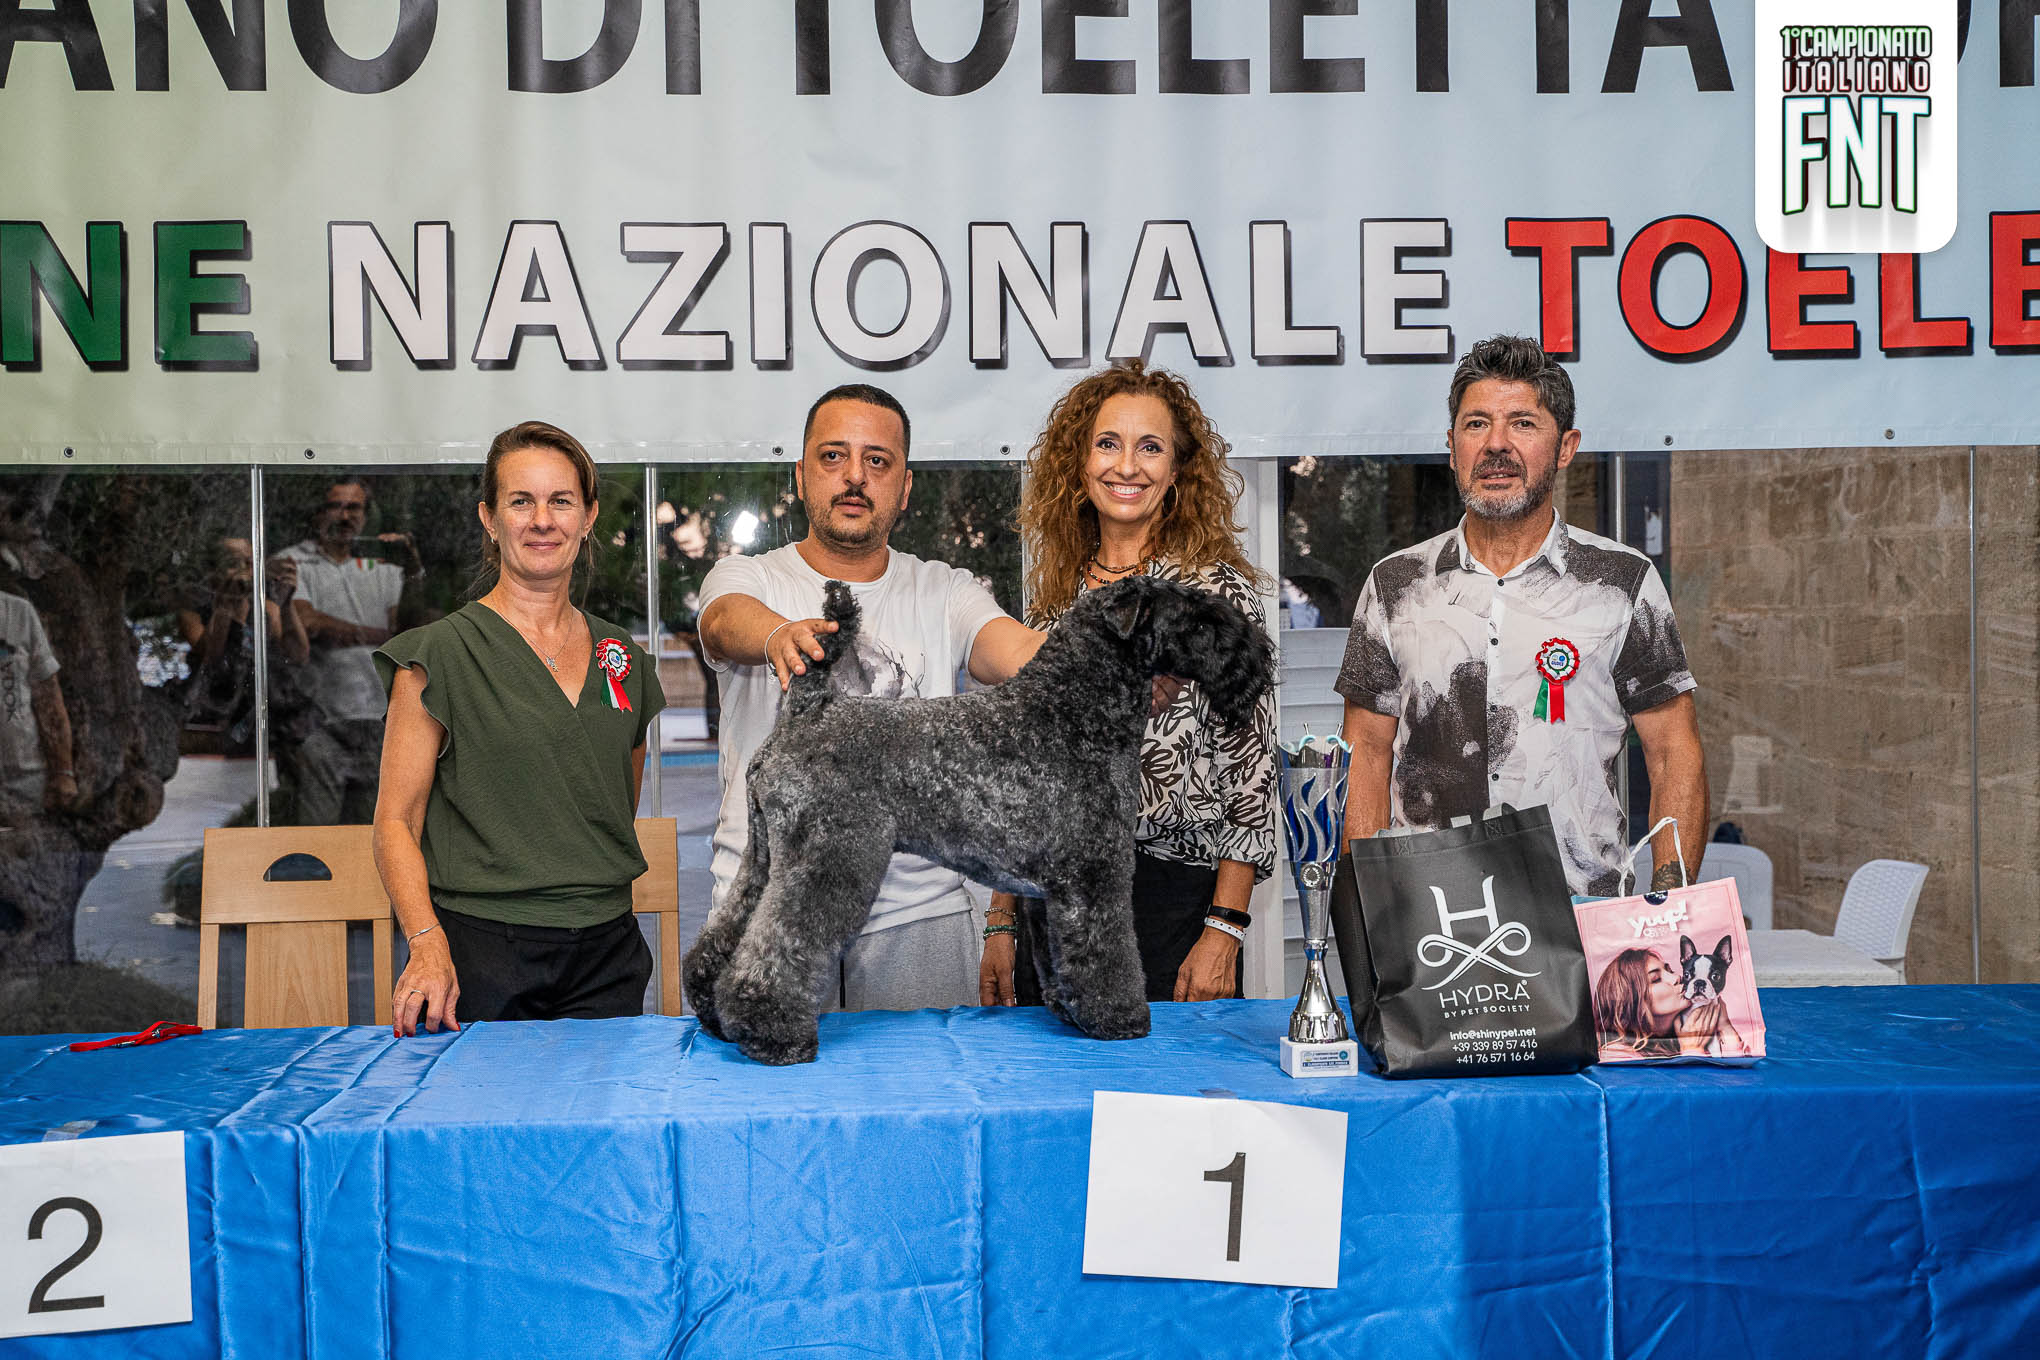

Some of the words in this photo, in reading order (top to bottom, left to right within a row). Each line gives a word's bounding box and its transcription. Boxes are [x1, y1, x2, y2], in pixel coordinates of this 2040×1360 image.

[328, 219, 1454, 371] NAZIONALE
[1444, 1010, 1457, 1019] BY
[1460, 1007, 1481, 1017] PET
[1483, 1004, 1531, 1014] SOCIETY
[1452, 1042, 1471, 1053] +39
[1472, 1041, 1490, 1052] 339
[1492, 1040, 1504, 1051] 89
[1506, 1039, 1518, 1050] 57
[1519, 1038, 1538, 1049] 416
[1456, 1054, 1473, 1064] +41
[1475, 1053, 1488, 1064] 76
[1490, 1053, 1507, 1063] 571
[1510, 1052, 1522, 1062] 16
[1523, 1051, 1536, 1061] 64
[1204, 1152, 1246, 1262] 1
[27, 1196, 105, 1314] 2
